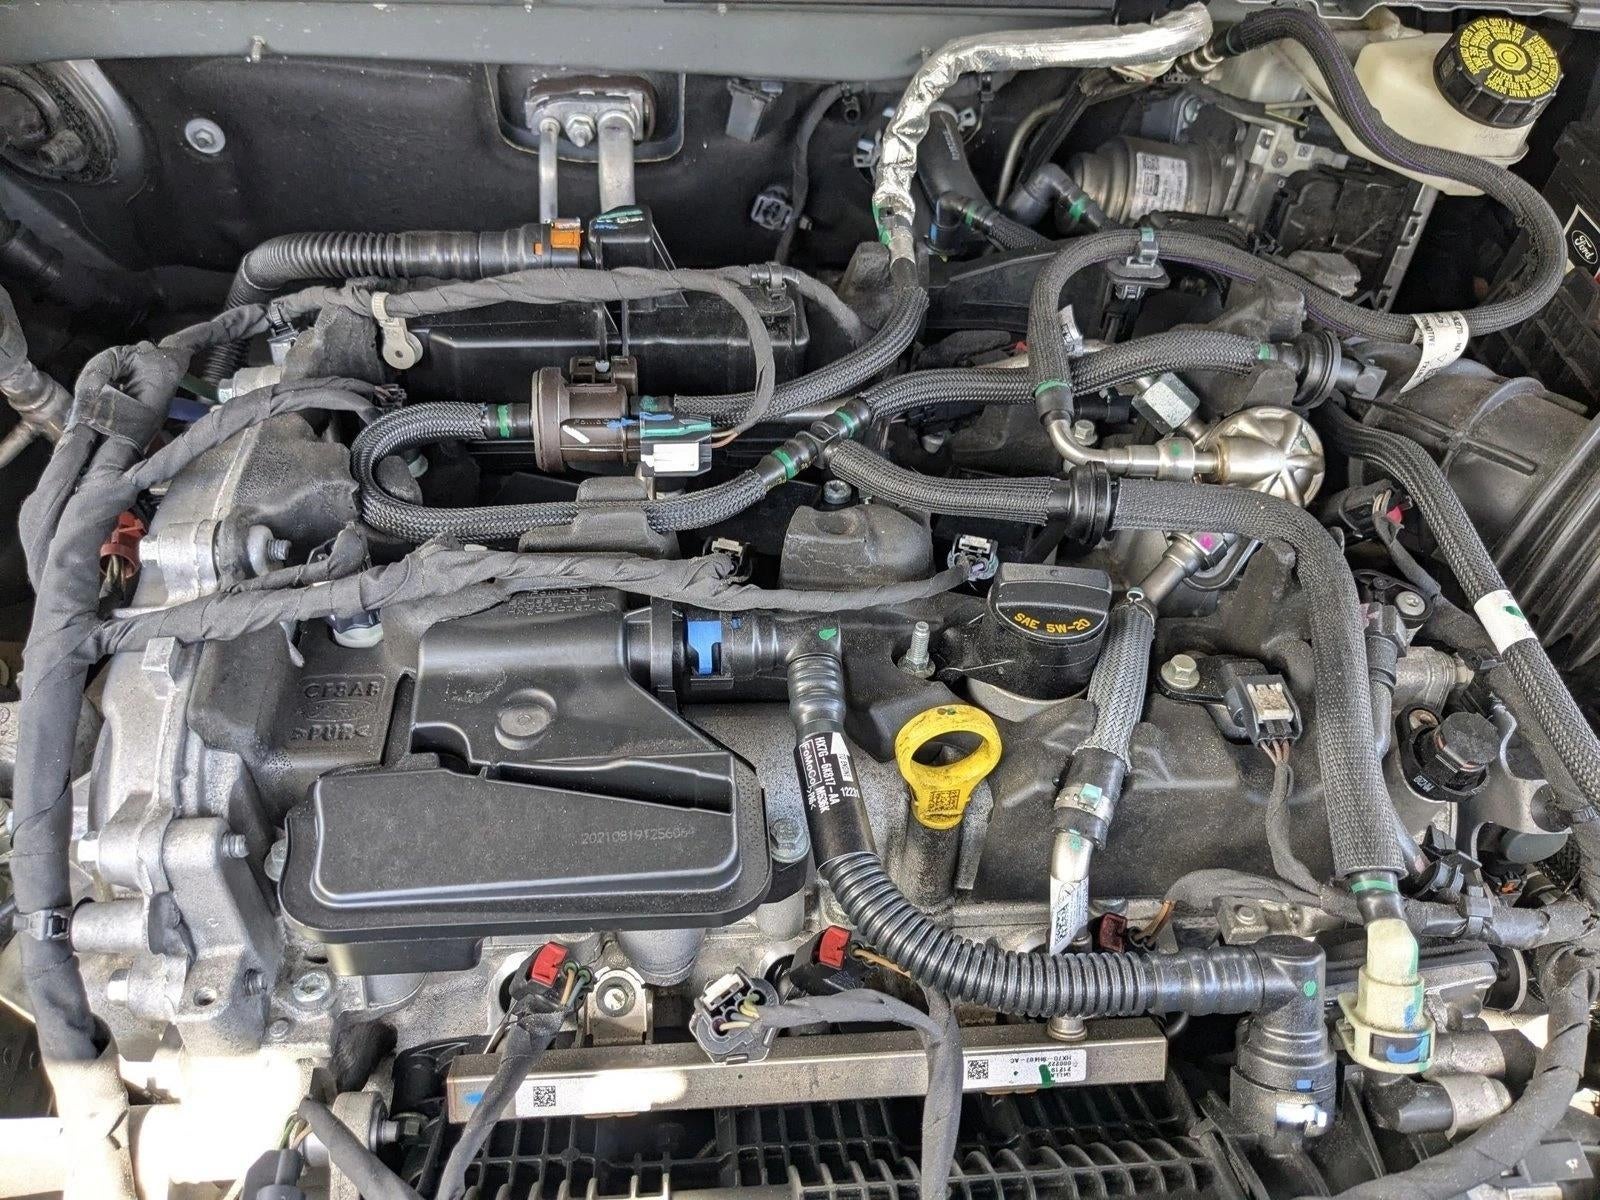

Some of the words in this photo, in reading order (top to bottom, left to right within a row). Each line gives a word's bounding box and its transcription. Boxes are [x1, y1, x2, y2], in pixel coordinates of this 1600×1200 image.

[1472, 20, 1490, 30] FROM
[1514, 22, 1526, 32] DOT
[1483, 79, 1506, 94] DEPOSE
[1509, 89, 1529, 97] AVANT
[1574, 235, 1595, 260] Ford
[1014, 612, 1040, 630] SAE
[1045, 618, 1091, 633] 5W-20
[801, 742, 818, 785] FoMoCo
